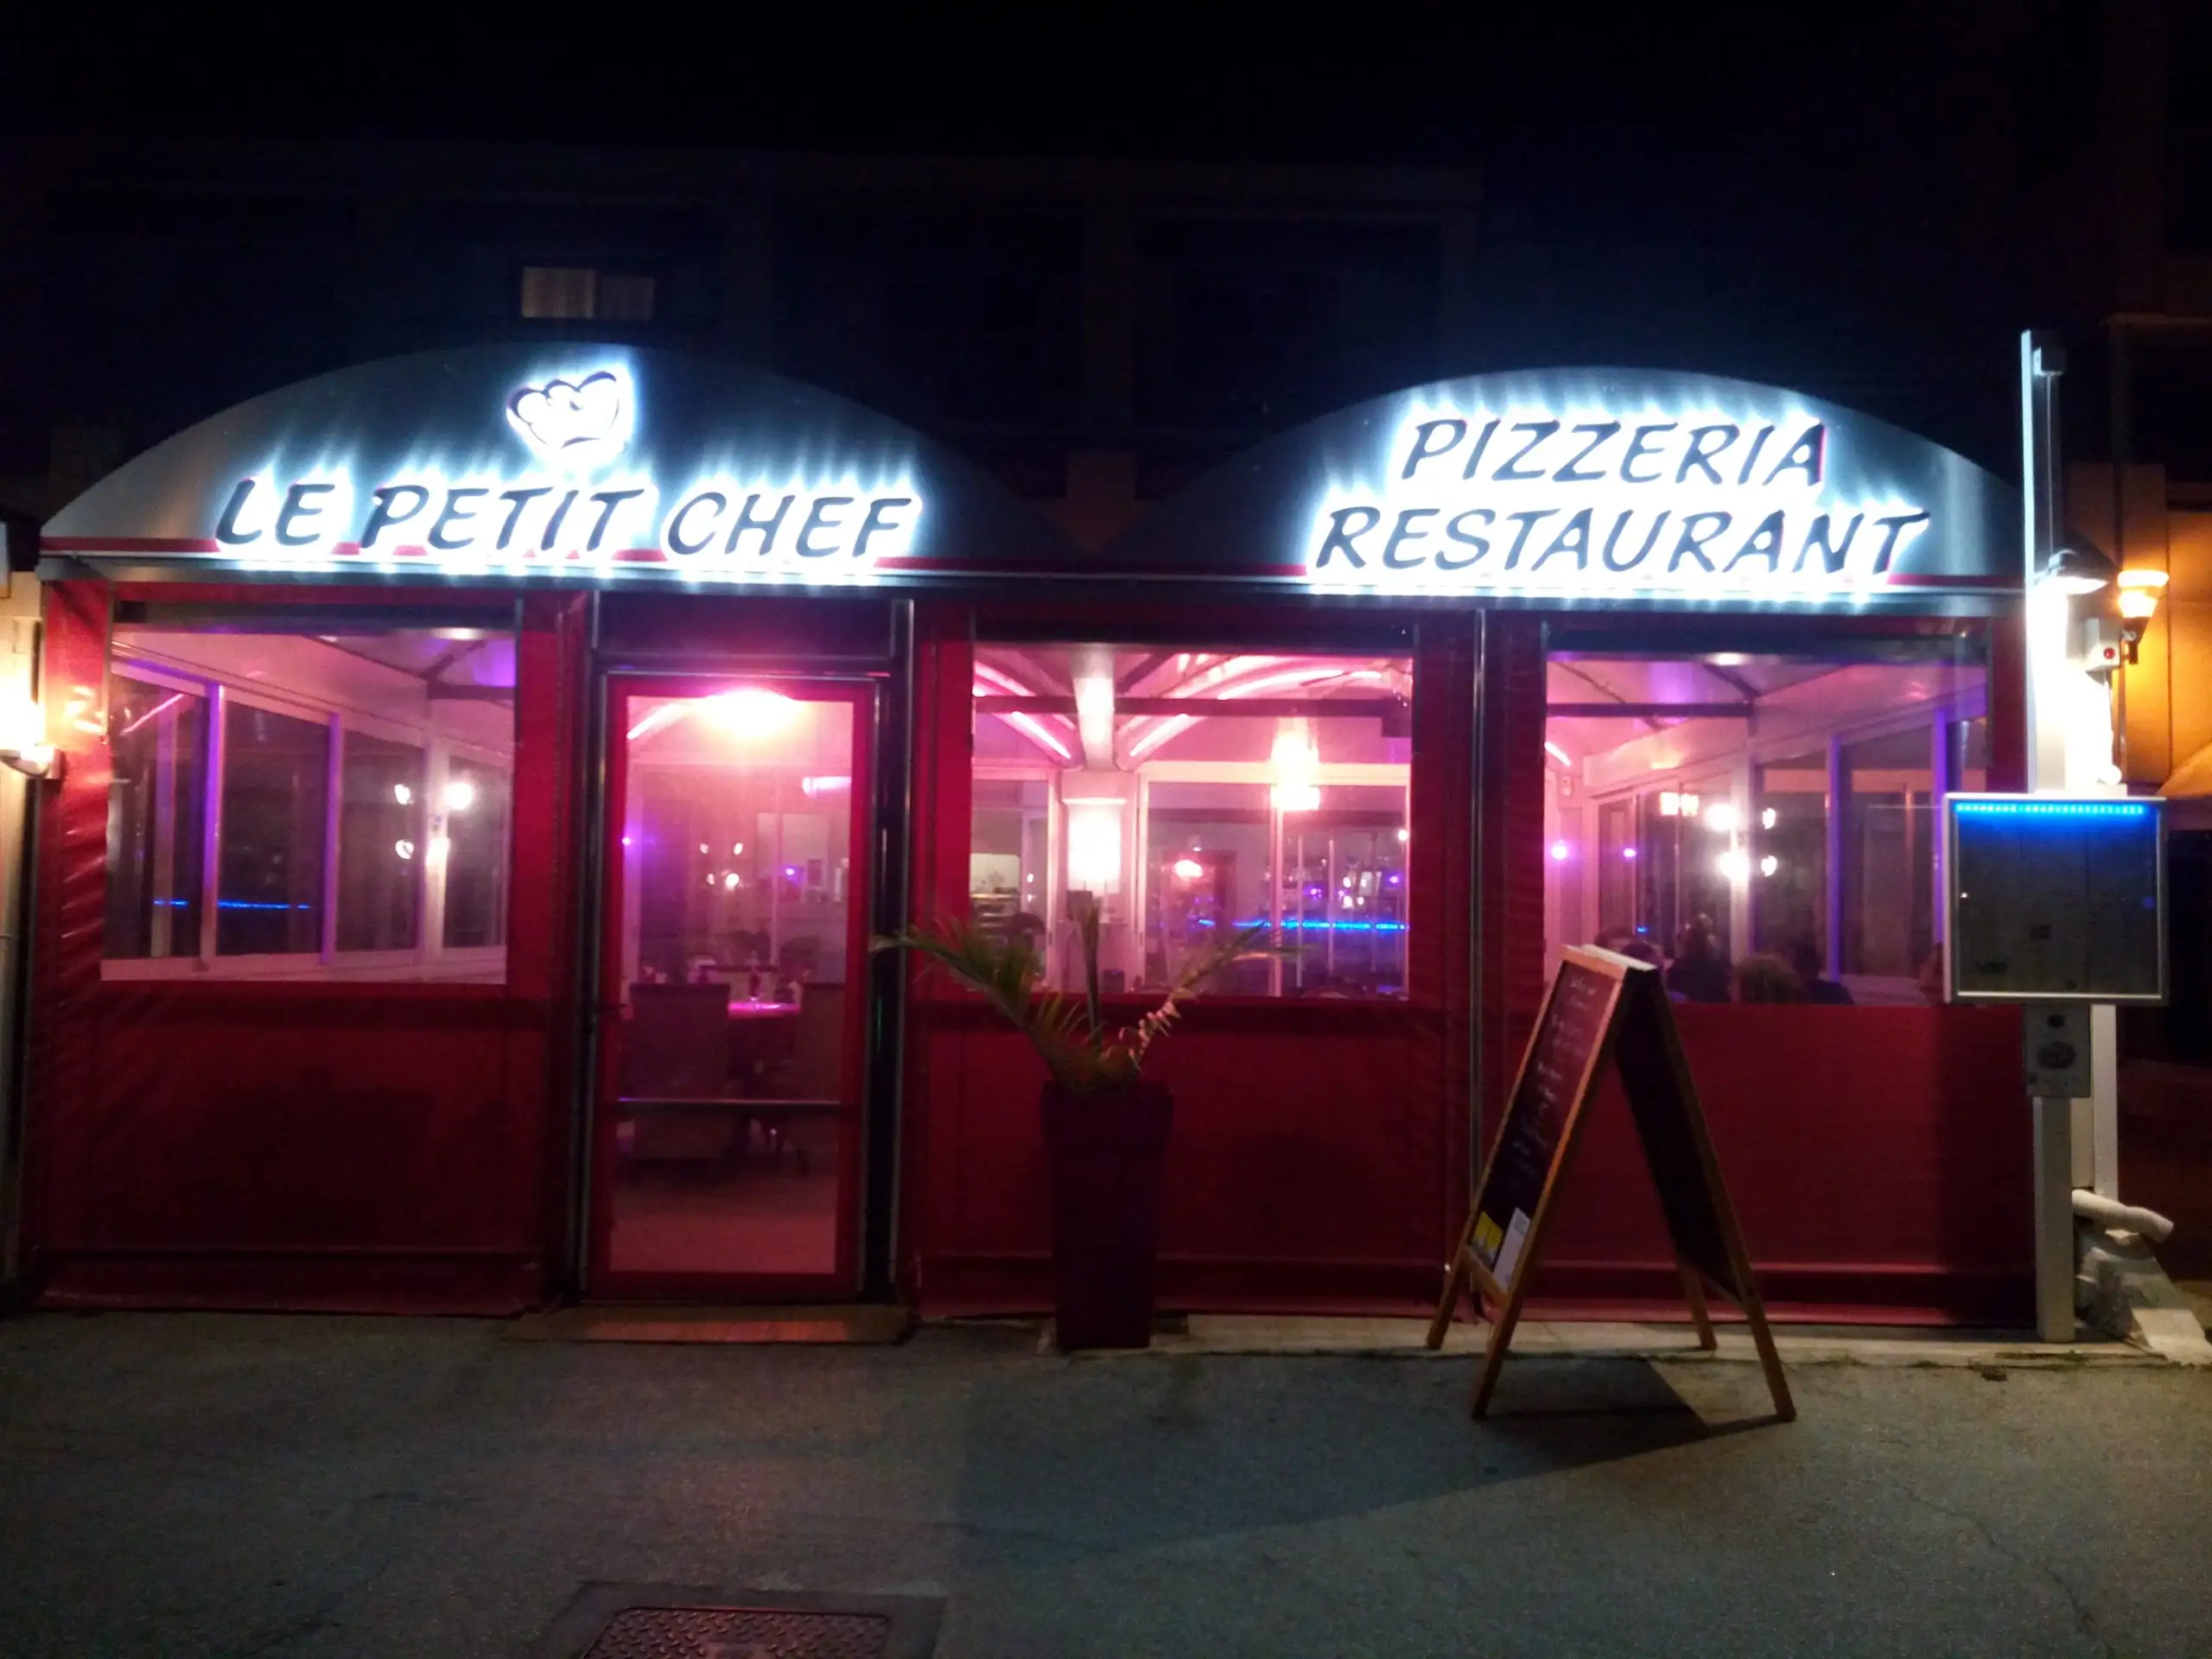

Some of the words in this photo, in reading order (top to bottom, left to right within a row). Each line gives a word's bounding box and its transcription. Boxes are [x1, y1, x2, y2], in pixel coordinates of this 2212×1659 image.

[1401, 418, 1827, 486] PIZZERIA
[215, 476, 335, 547] LE
[359, 484, 645, 551] PETIT
[666, 492, 912, 559] CHEF
[1315, 505, 1930, 575] RESTAURANT
